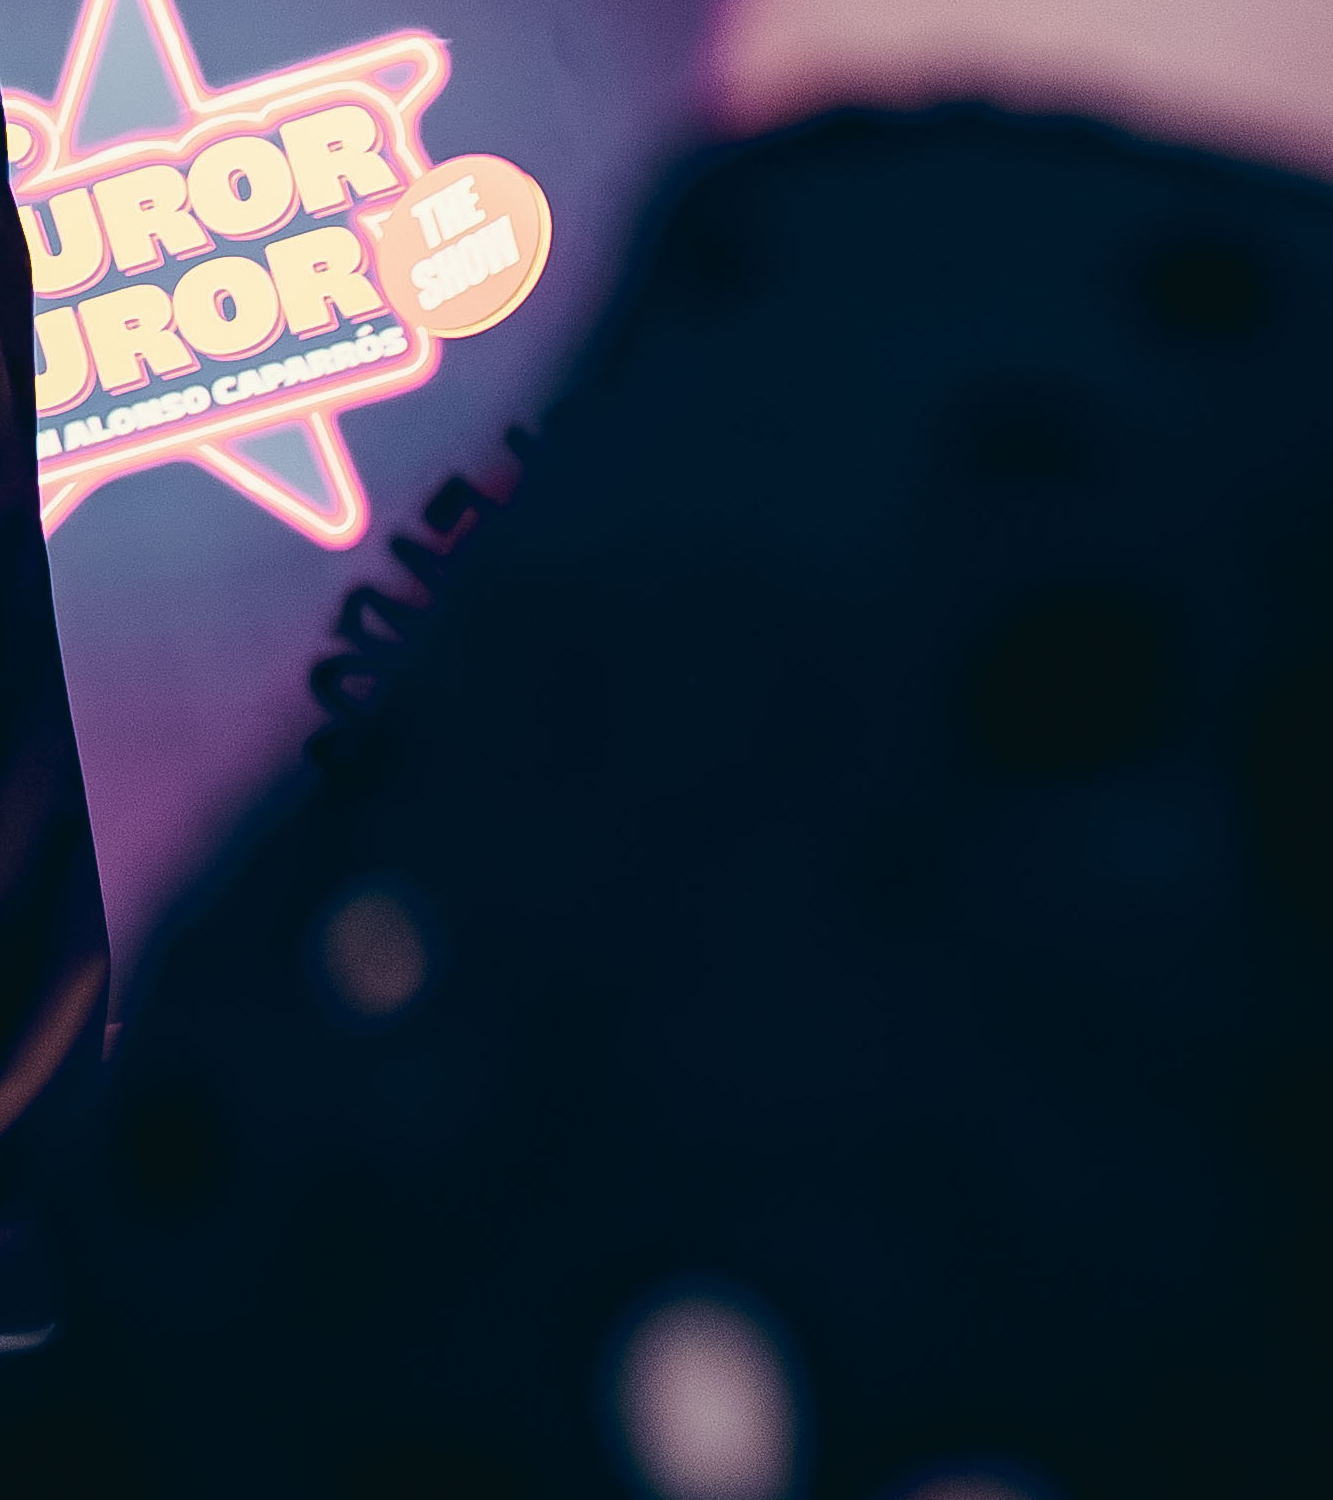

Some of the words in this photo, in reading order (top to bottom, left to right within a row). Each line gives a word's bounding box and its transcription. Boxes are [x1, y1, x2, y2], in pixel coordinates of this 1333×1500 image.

[17, 105, 398, 293] UROR
[410, 174, 487, 249] THE
[410, 214, 521, 311] SHOW
[63, 385, 211, 452] ALONSO
[211, 324, 409, 406] CAPARRÓS
